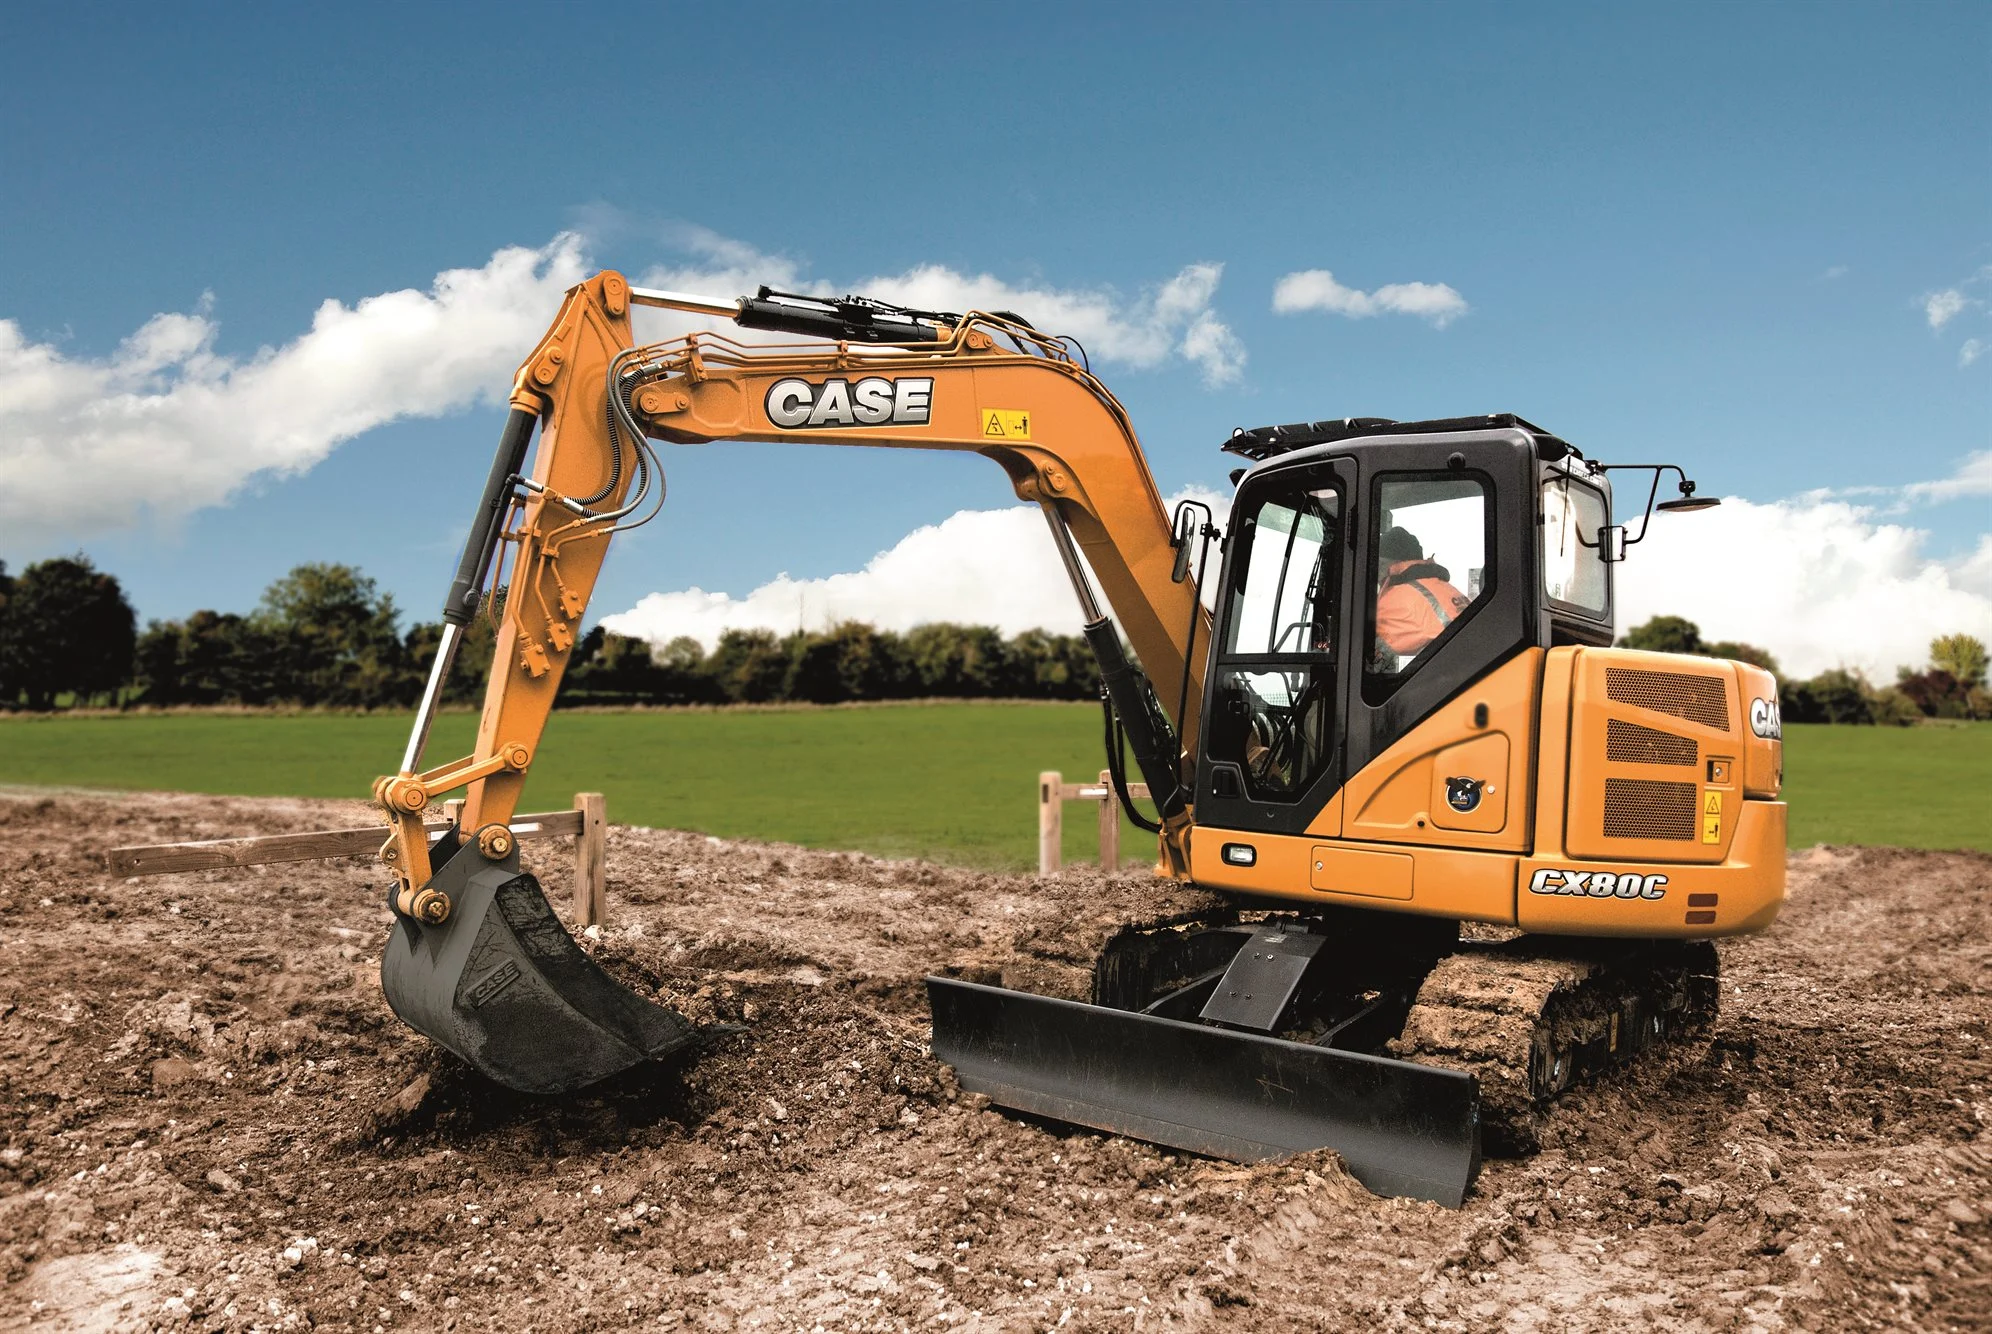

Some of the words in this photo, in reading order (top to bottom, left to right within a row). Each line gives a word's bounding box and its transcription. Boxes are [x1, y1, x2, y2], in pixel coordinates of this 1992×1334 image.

[766, 376, 933, 427] CASE
[1530, 869, 1668, 899] CX80C
[475, 961, 517, 998] CASE
